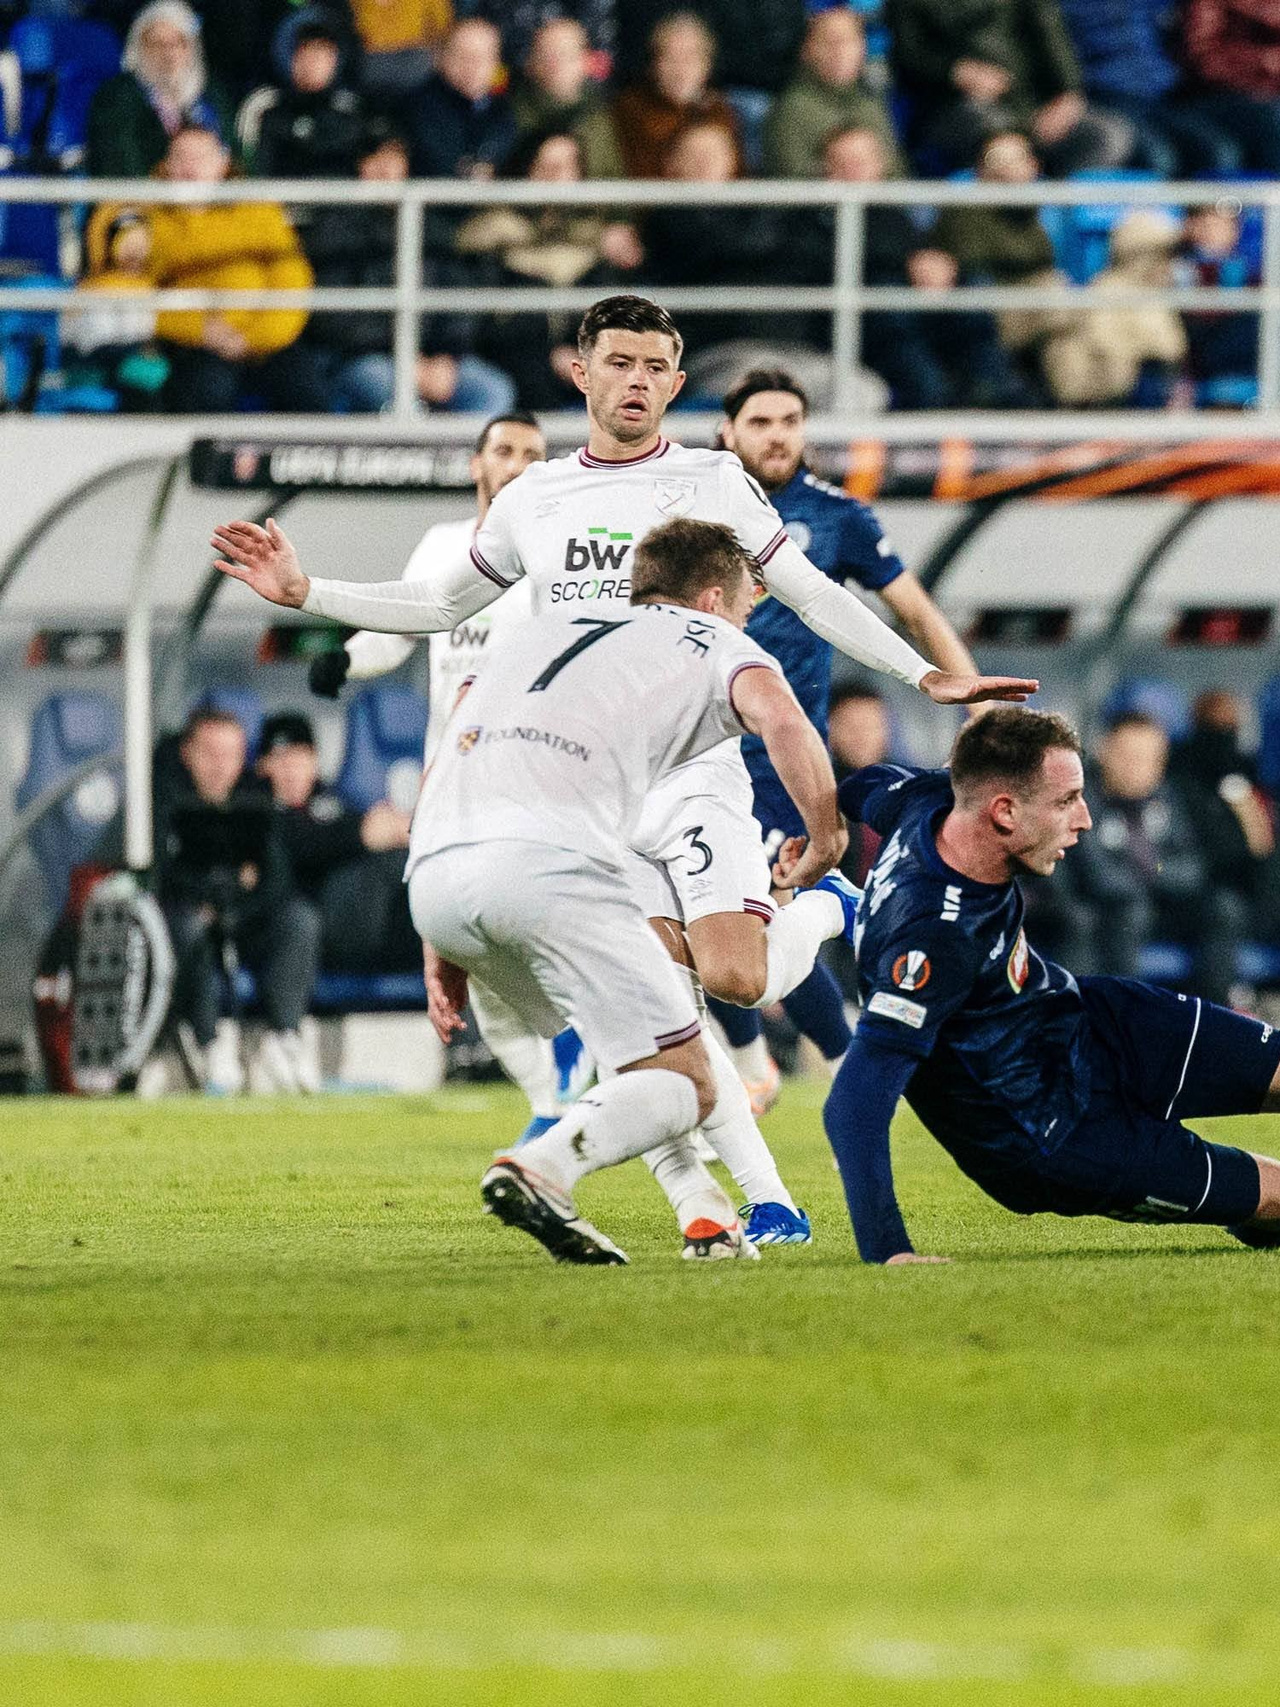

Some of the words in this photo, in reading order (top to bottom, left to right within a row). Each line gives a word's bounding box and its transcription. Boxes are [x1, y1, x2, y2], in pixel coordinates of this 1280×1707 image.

[551, 579, 631, 603] SCORE
[527, 618, 635, 692] 7
[683, 825, 713, 876] 3
